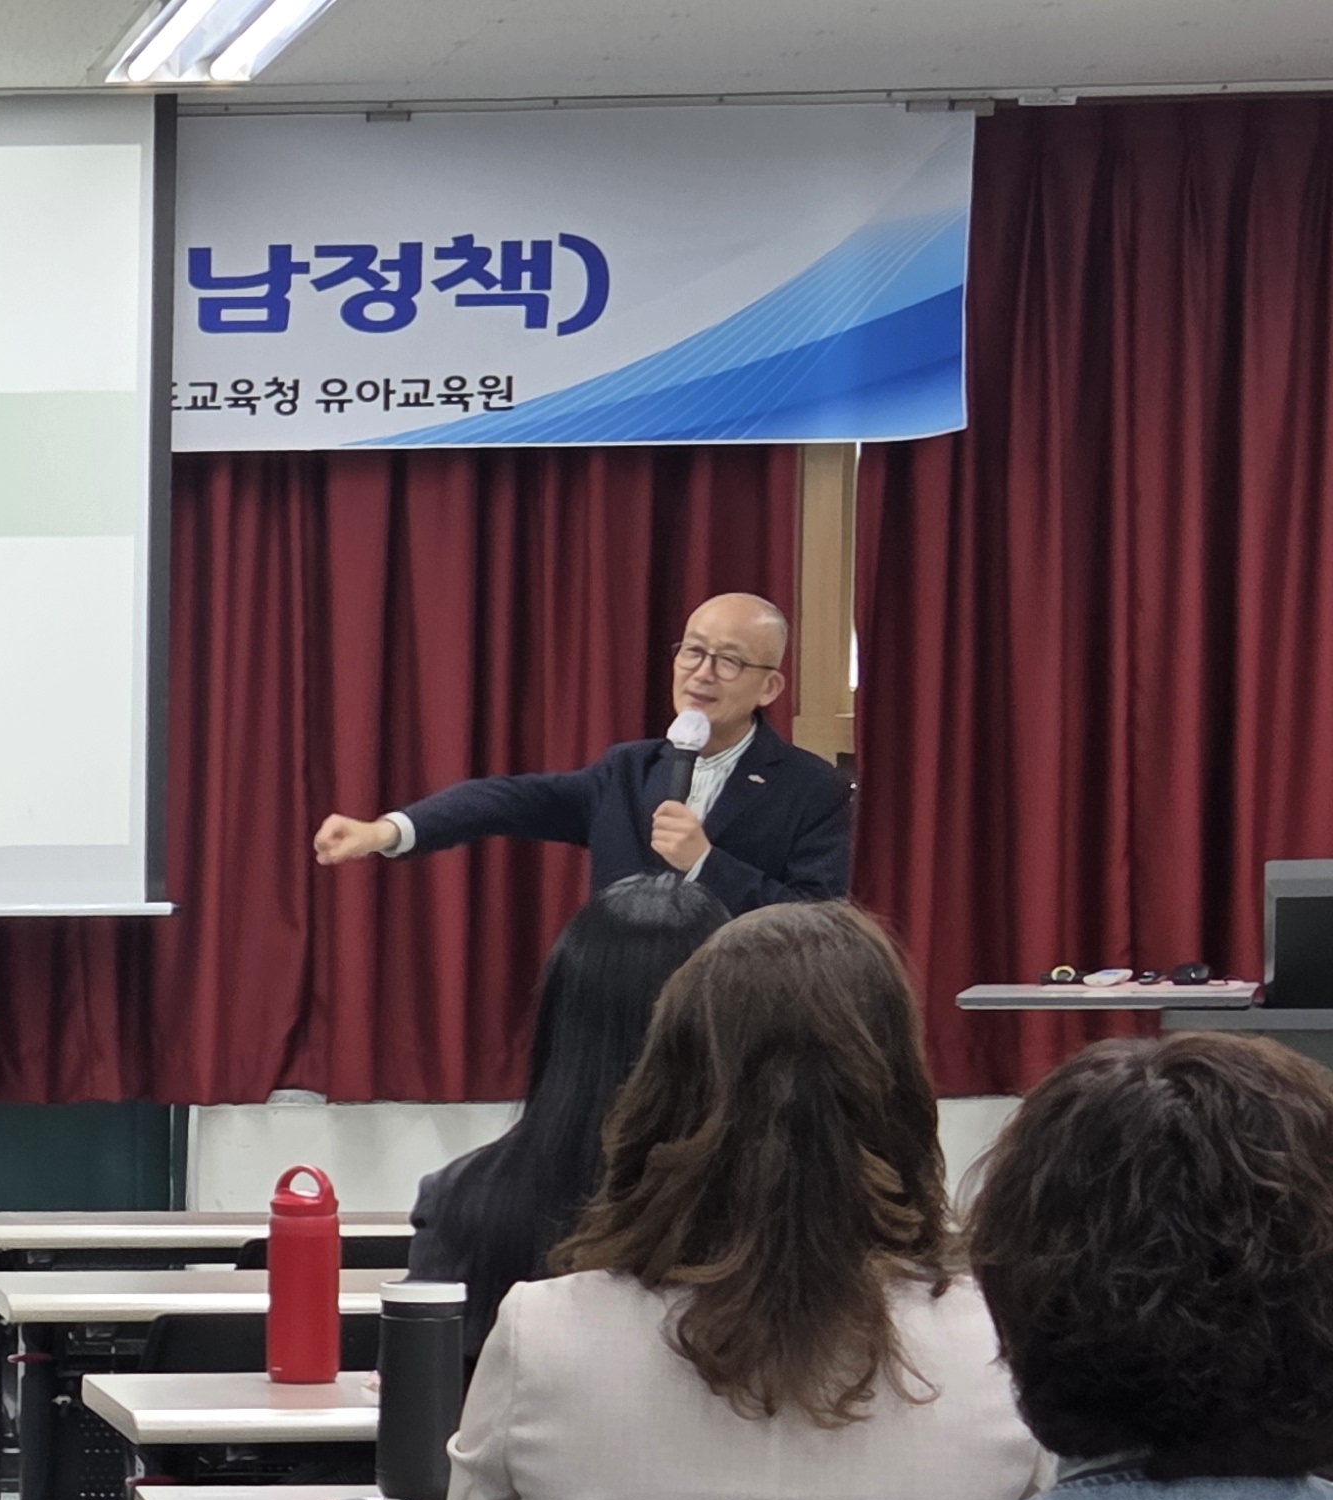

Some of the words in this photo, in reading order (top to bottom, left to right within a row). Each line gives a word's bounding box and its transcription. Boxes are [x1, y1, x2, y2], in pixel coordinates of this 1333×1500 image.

[187, 232, 611, 336] 남정책)
[171, 376, 300, 416] 교육청
[315, 375, 514, 412] 유아교육원
